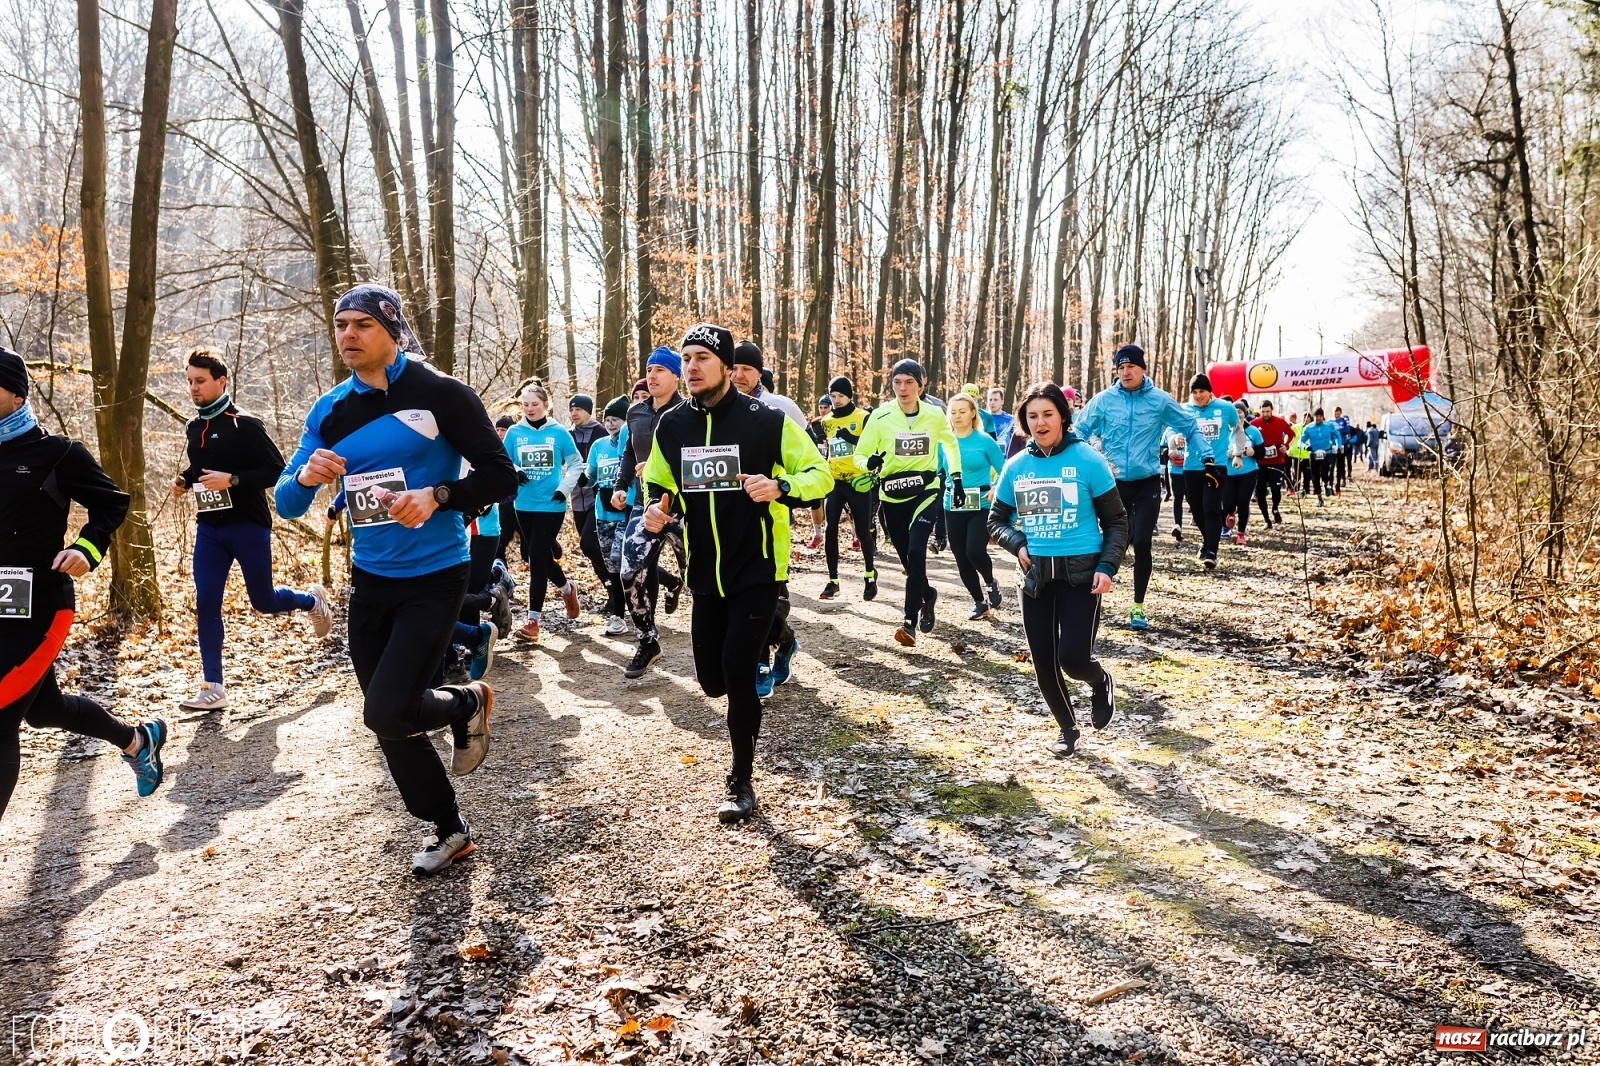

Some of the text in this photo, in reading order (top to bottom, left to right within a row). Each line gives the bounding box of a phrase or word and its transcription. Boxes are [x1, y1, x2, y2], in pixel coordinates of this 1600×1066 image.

[1284, 366, 1350, 377] TWARDZIELA
[1291, 377, 1343, 387] RACIBÓRZ
[832, 443, 848, 452] 145
[901, 440, 924, 450] 025
[527, 452, 548, 461] 032
[692, 460, 727, 478] 060
[362, 472, 395, 482] Twardziela
[886, 478, 922, 491] adidas
[200, 490, 222, 503] 035
[355, 490, 380, 511] 03
[1023, 490, 1049, 506] 126
